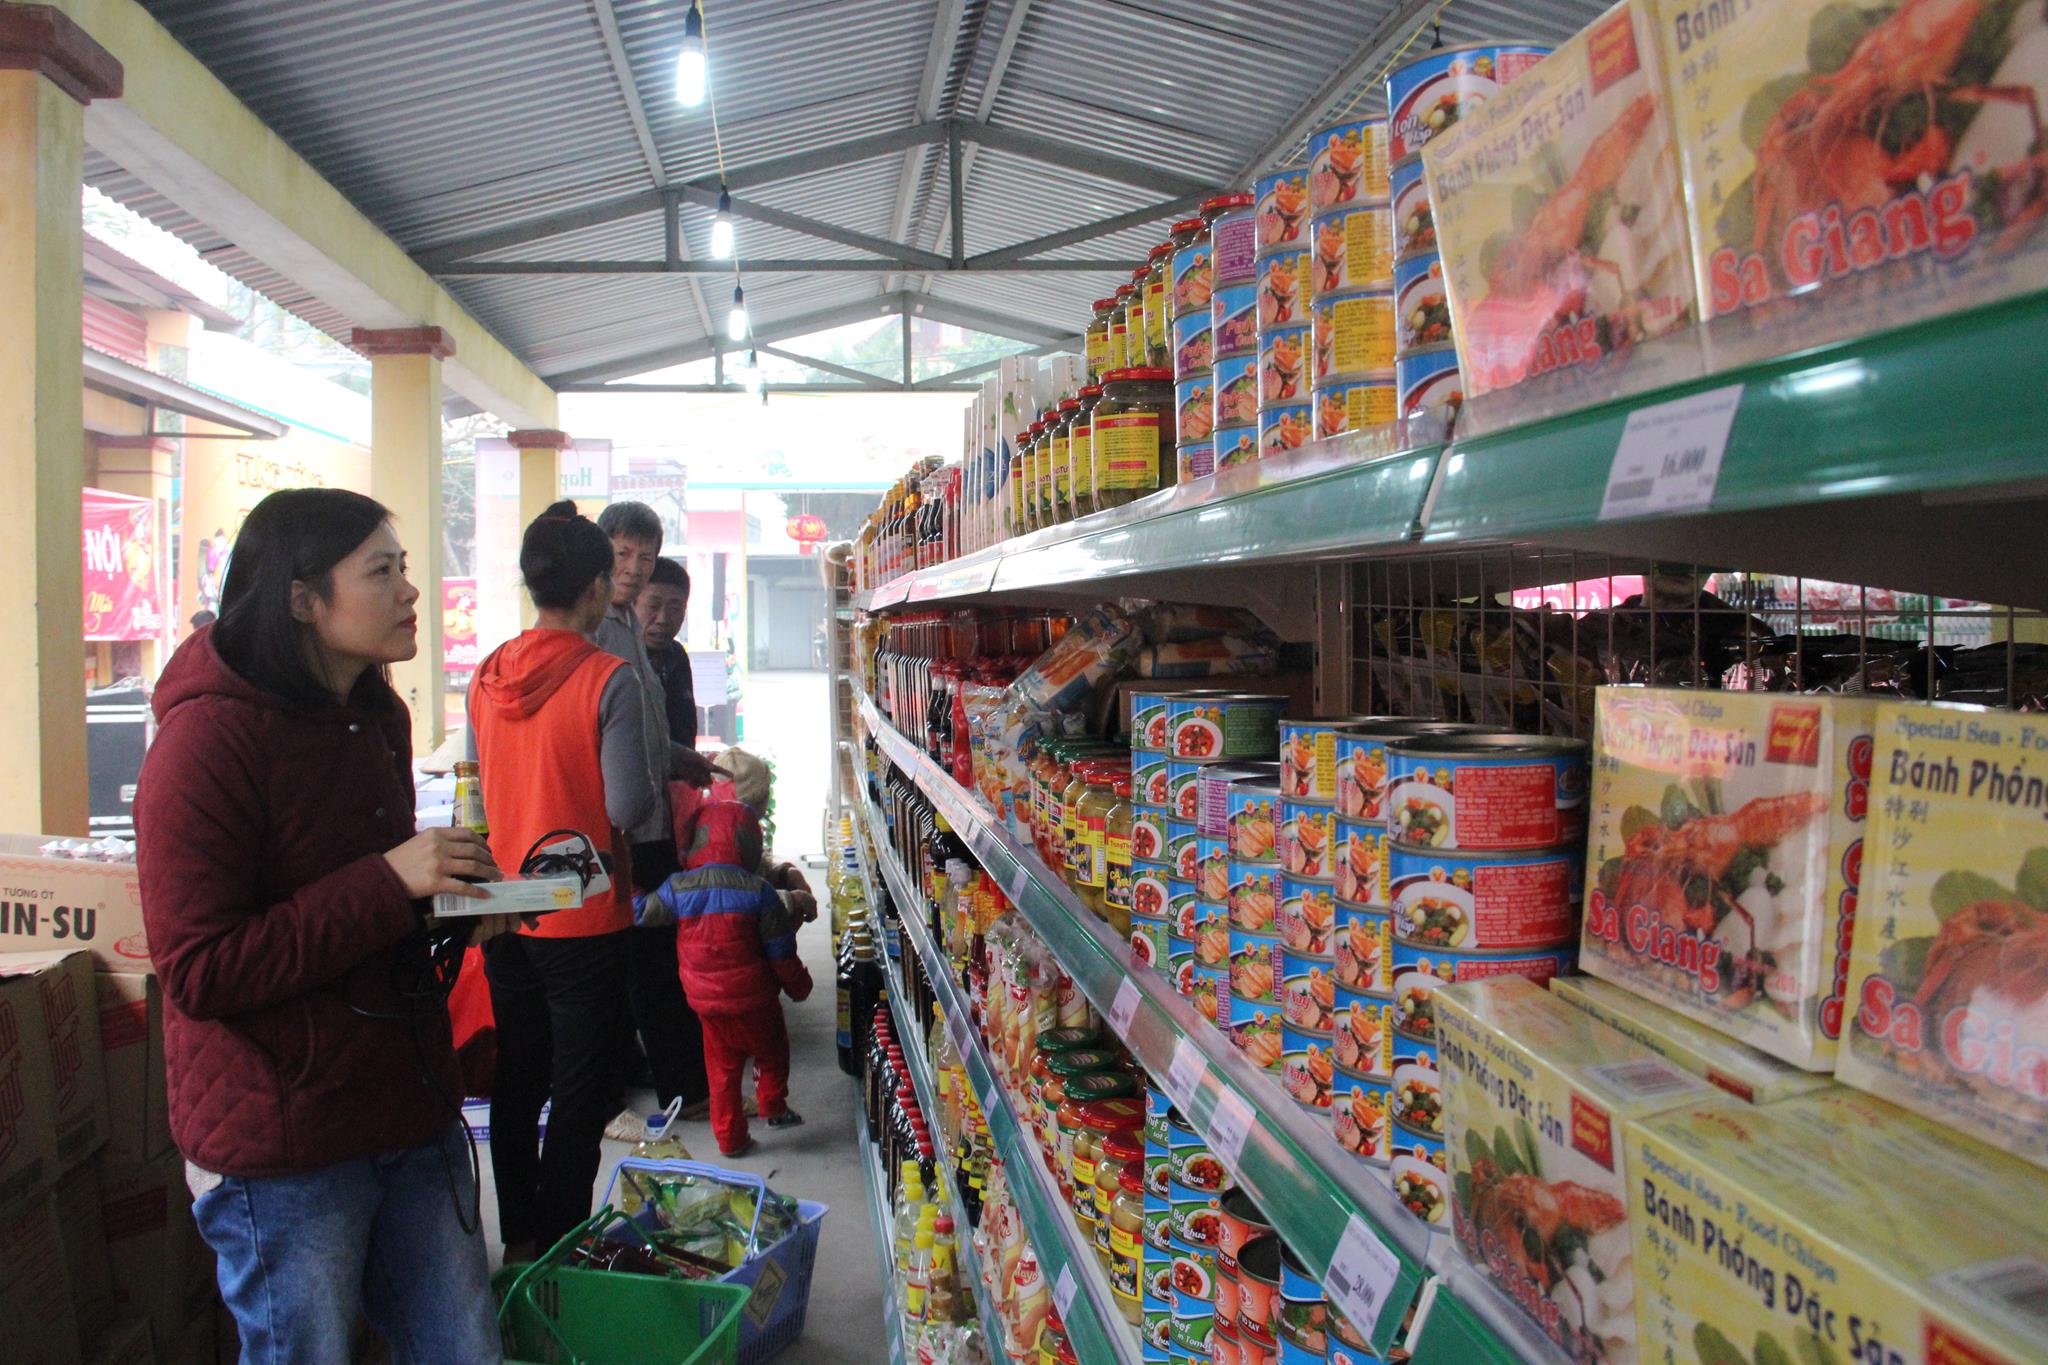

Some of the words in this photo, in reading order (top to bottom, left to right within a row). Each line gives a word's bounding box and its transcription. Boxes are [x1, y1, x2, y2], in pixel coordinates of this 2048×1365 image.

[1708, 244, 1772, 317] Sa
[1780, 166, 1978, 288] Giang
[84, 524, 123, 581] NỘI
[1895, 715, 1961, 743] Special
[1888, 748, 1960, 796] Bánh
[1588, 888, 1620, 943] Sa
[1626, 903, 1722, 993] Giang
[1858, 976, 1923, 1052] Sa
[1641, 1144, 1692, 1191] Special
[1695, 1177, 1723, 1212] Sea
[1735, 1202, 1779, 1248] Food
[1782, 1232, 1838, 1284] Chips
[1643, 1177, 1695, 1245] Bánh
